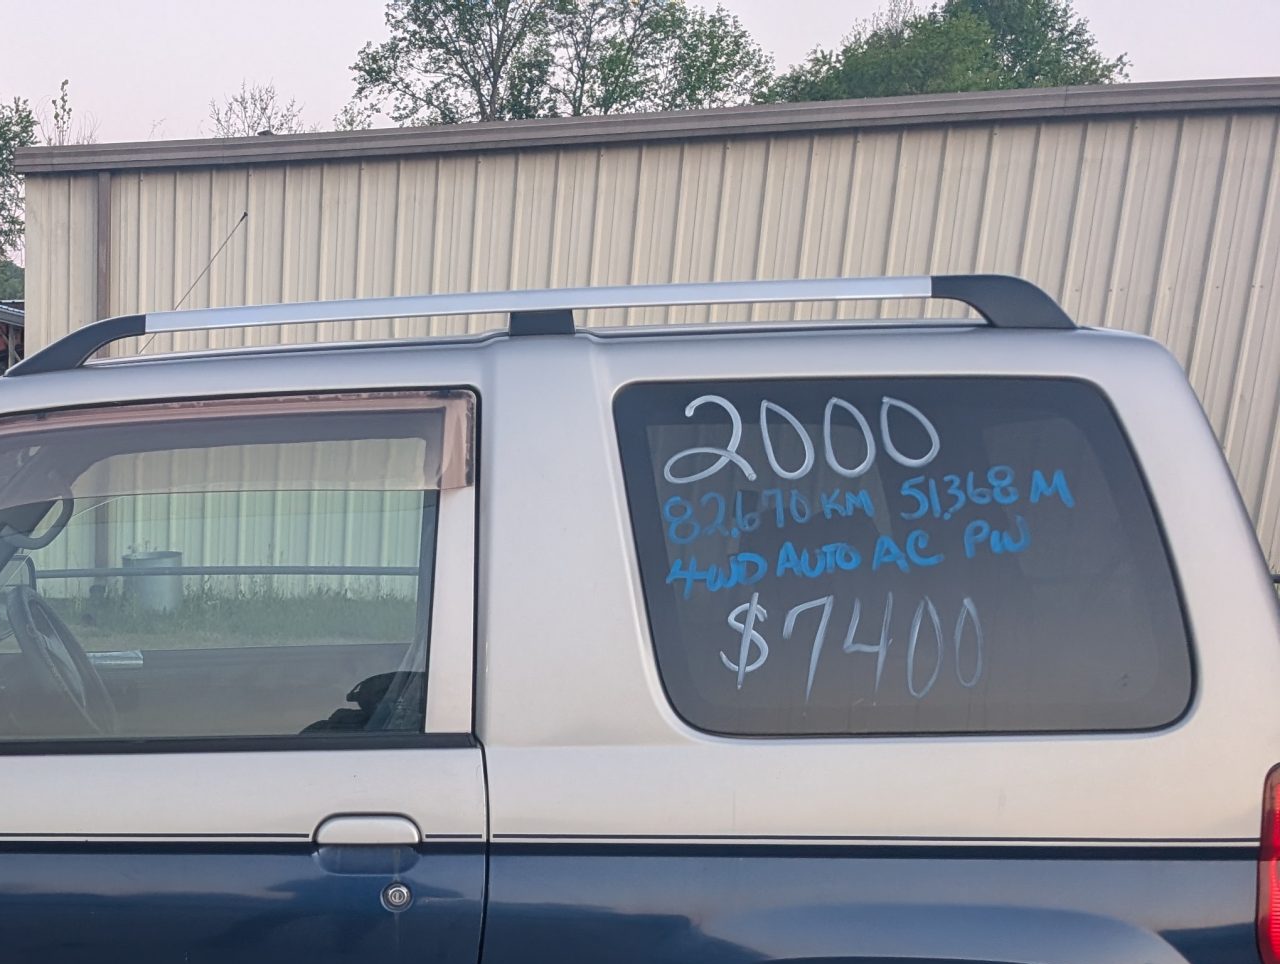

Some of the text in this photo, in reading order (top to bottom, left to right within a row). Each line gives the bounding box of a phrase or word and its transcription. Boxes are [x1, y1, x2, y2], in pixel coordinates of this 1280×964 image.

[664, 395, 940, 483] 2000
[820, 487, 876, 520] KM
[1029, 469, 1075, 508] M
[665, 515, 1030, 599] 4WD AUTO AC PW
[720, 592, 982, 701] $7400
